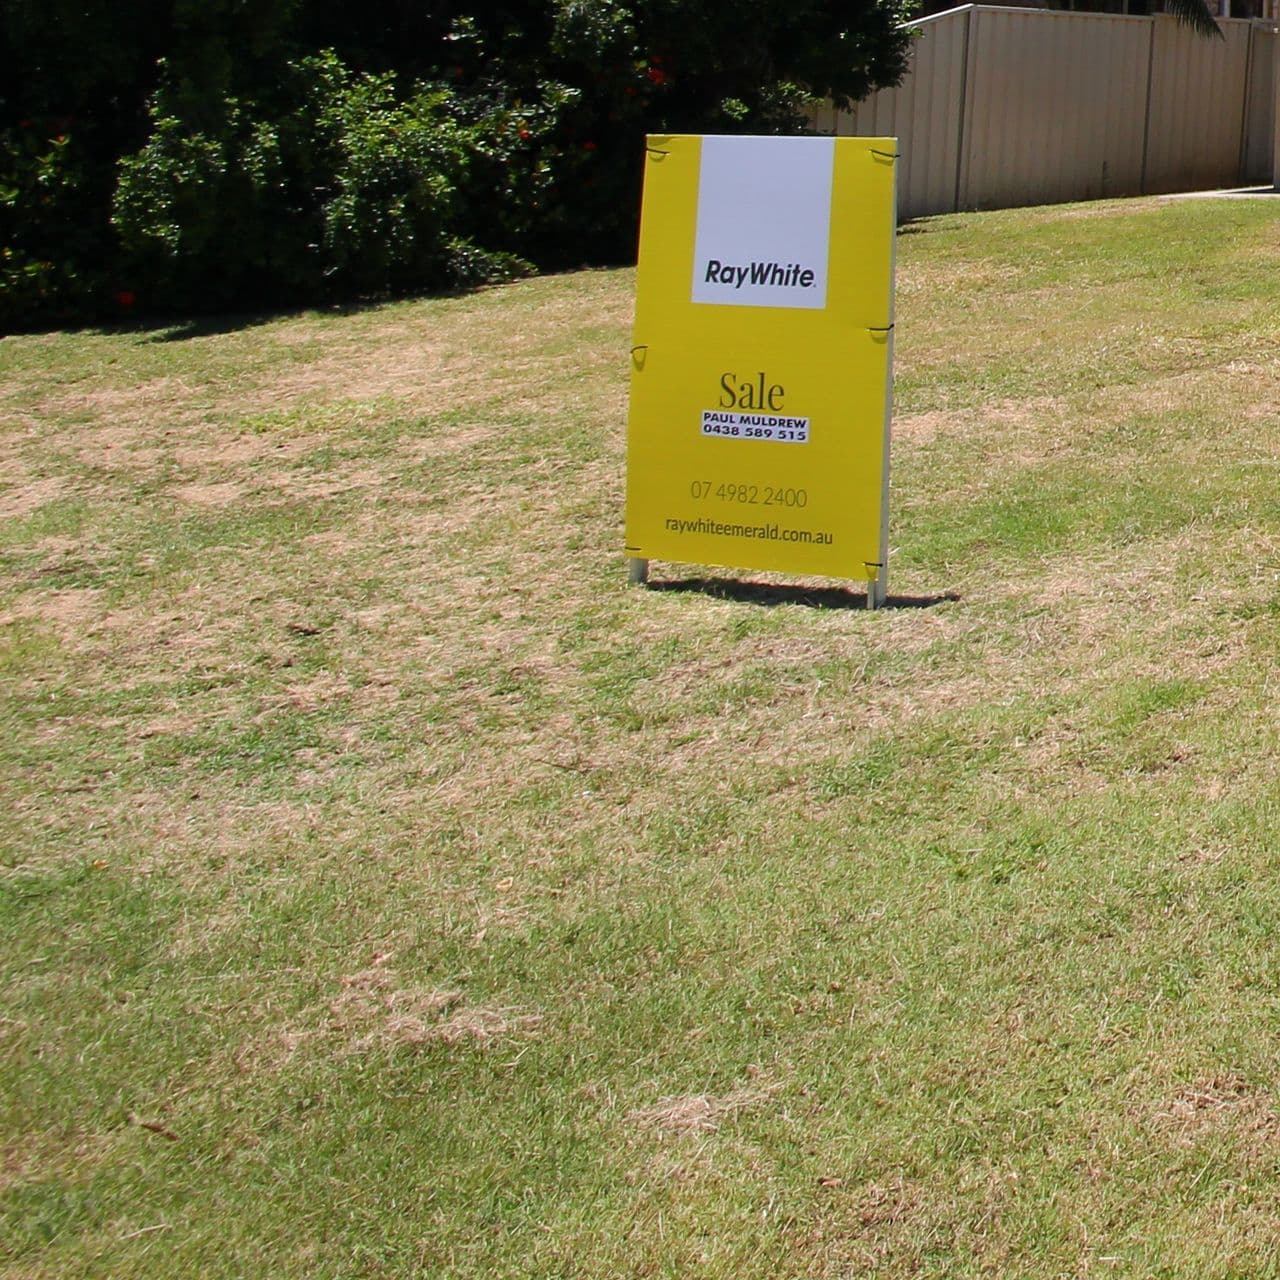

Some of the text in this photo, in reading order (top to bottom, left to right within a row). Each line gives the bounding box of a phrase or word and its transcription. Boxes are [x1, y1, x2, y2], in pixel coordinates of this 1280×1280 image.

[720, 372, 785, 411] Sale
[703, 412, 807, 429] PAUL MULDREW
[703, 424, 806, 441] 0438 589 515
[690, 480, 808, 508] 07 4982 2400
[665, 517, 833, 545] raywhiteemerald.com.au
